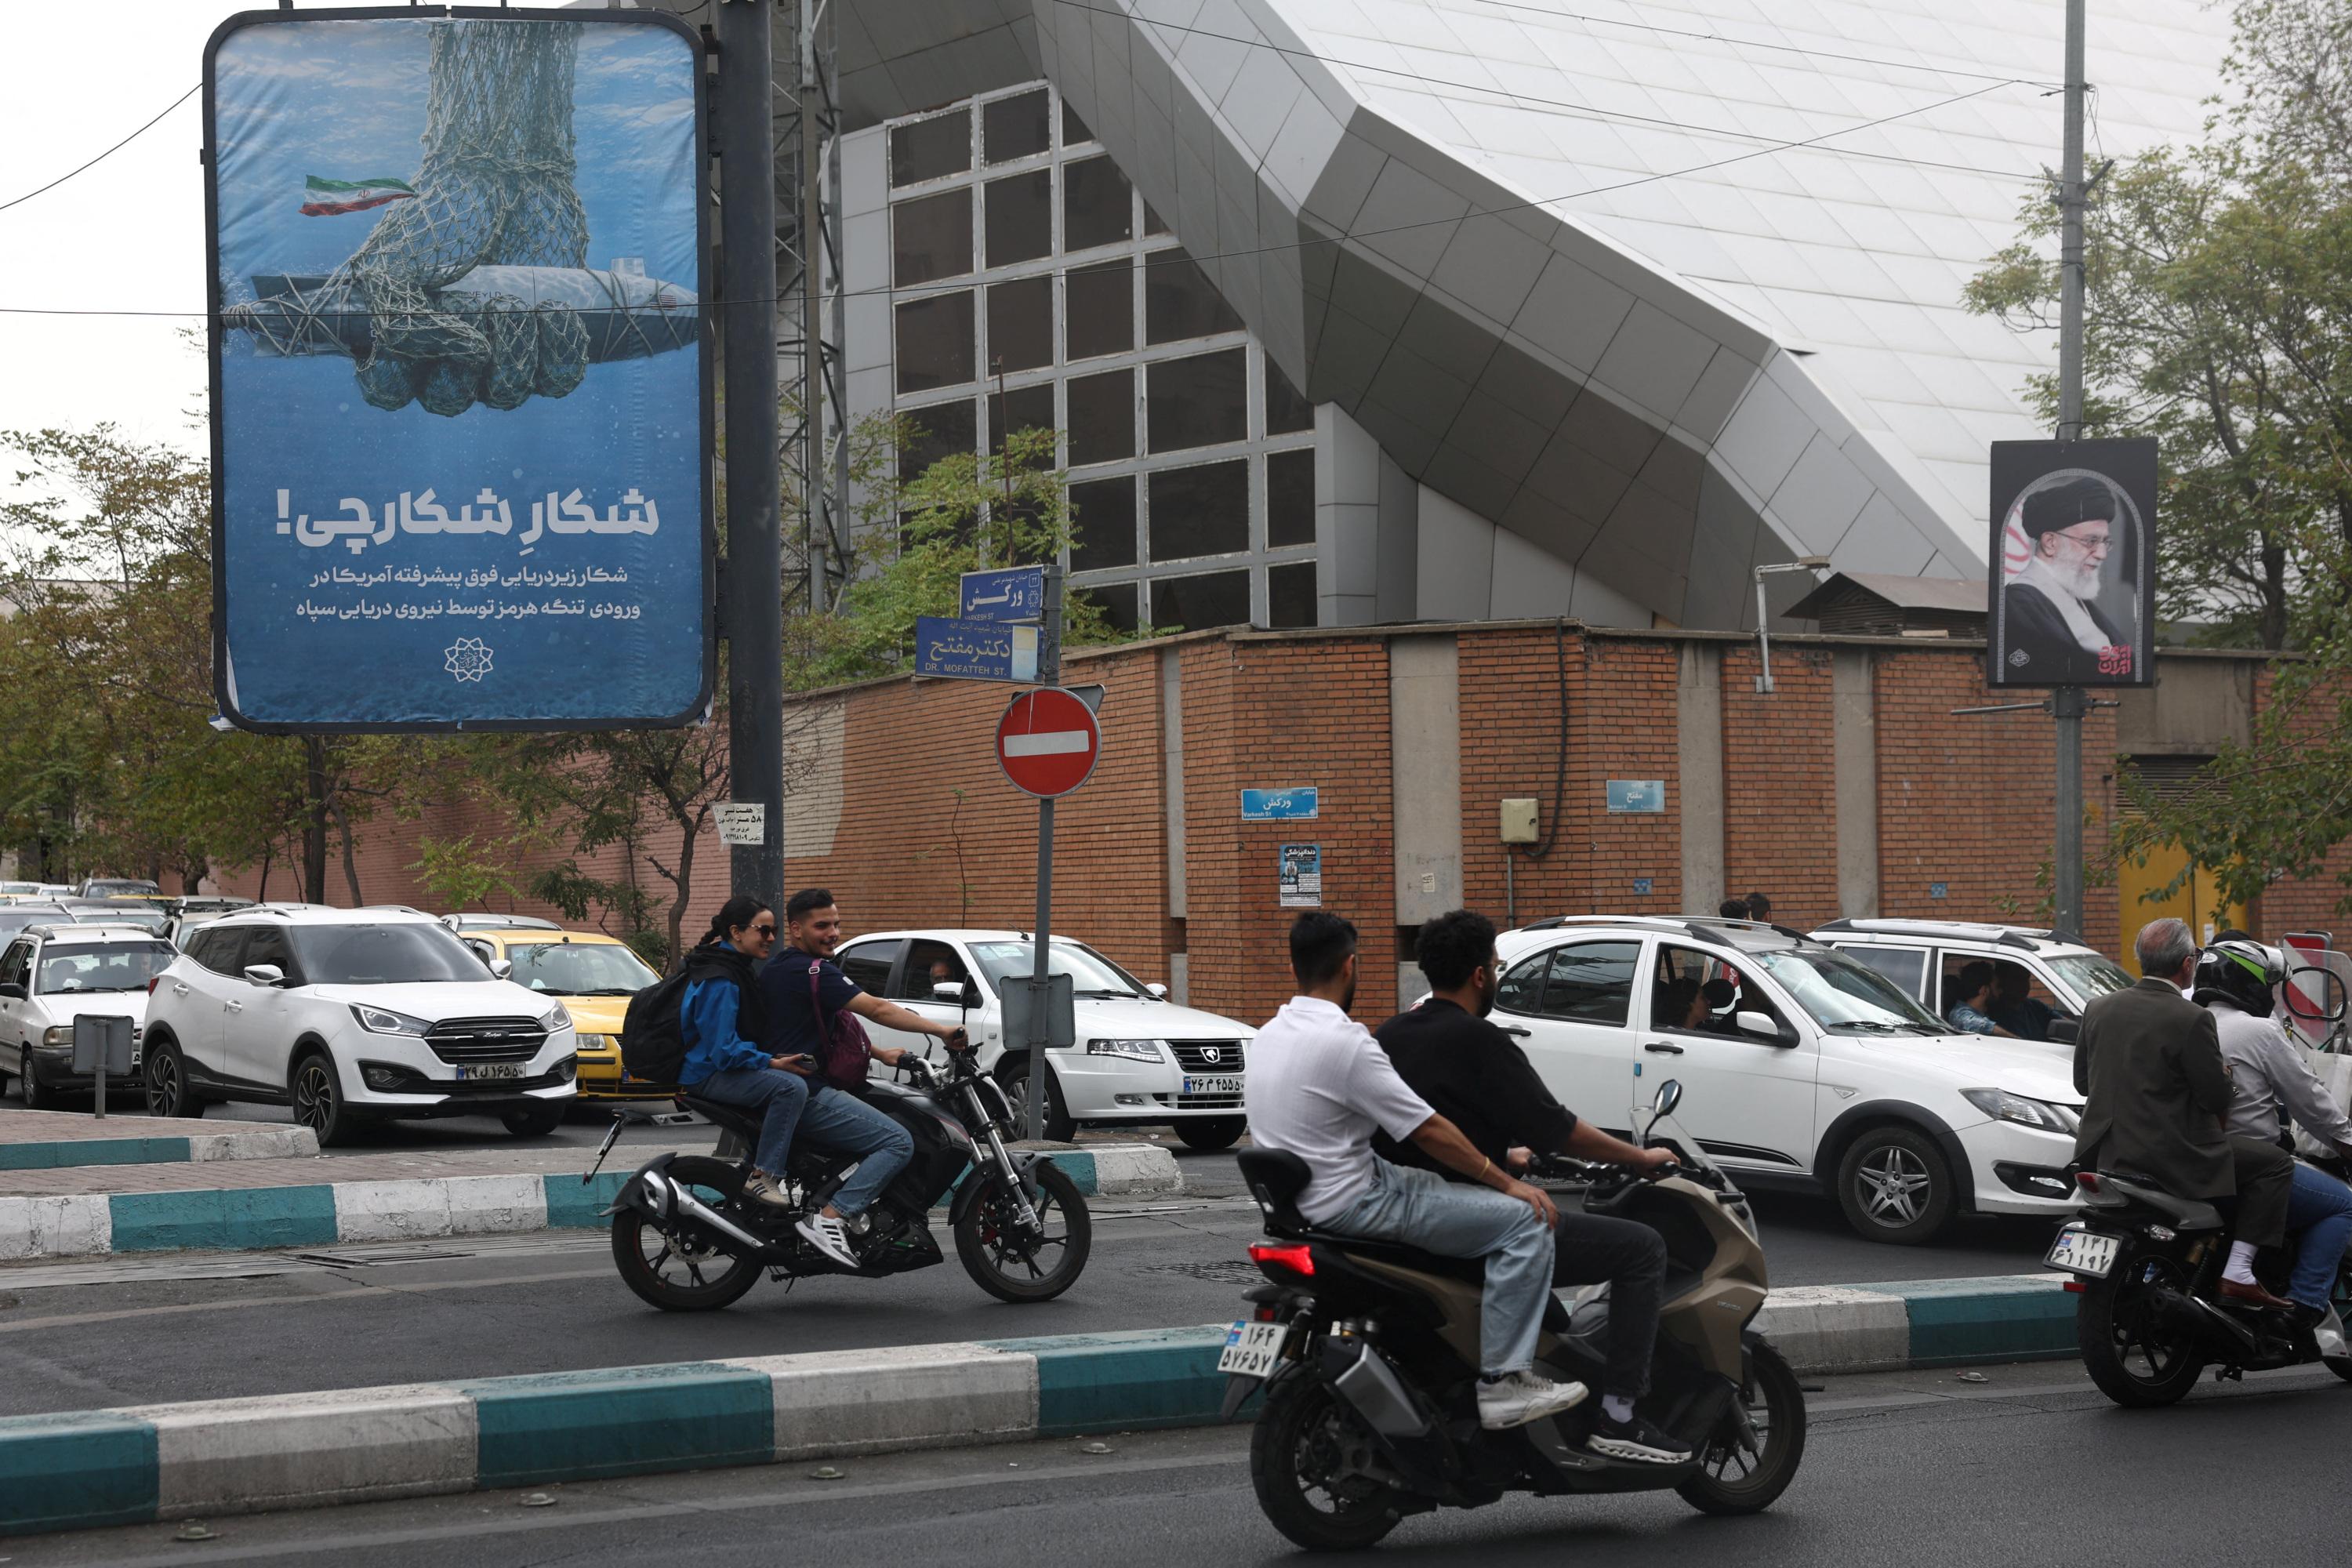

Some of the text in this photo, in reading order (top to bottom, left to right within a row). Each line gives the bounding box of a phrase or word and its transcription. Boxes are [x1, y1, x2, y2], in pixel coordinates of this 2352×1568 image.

[276, 487, 513, 554] شکارچی!
[309, 564, 628, 590] شکار زیردریایی فوق پیشرفته آمریکا در
[967, 583, 1023, 612] ورکش
[296, 598, 641, 622] ورودی تنگه هرمز توسط نیروی دریایی سپاه
[930, 636, 1010, 662] دکتر مفتح
[925, 662, 1007, 676] DR. MOFATTEH ST.
[1263, 797, 1291, 810] ورکش
[1284, 848, 1316, 857] دندانپزشکی
[1192, 1079, 1203, 1091] ۲۶
[1216, 1079, 1233, 1091] ۴۵۵
[2082, 1236, 2108, 1253] ۱۳۱
[1248, 1326, 1275, 1346] ۱۶۴
